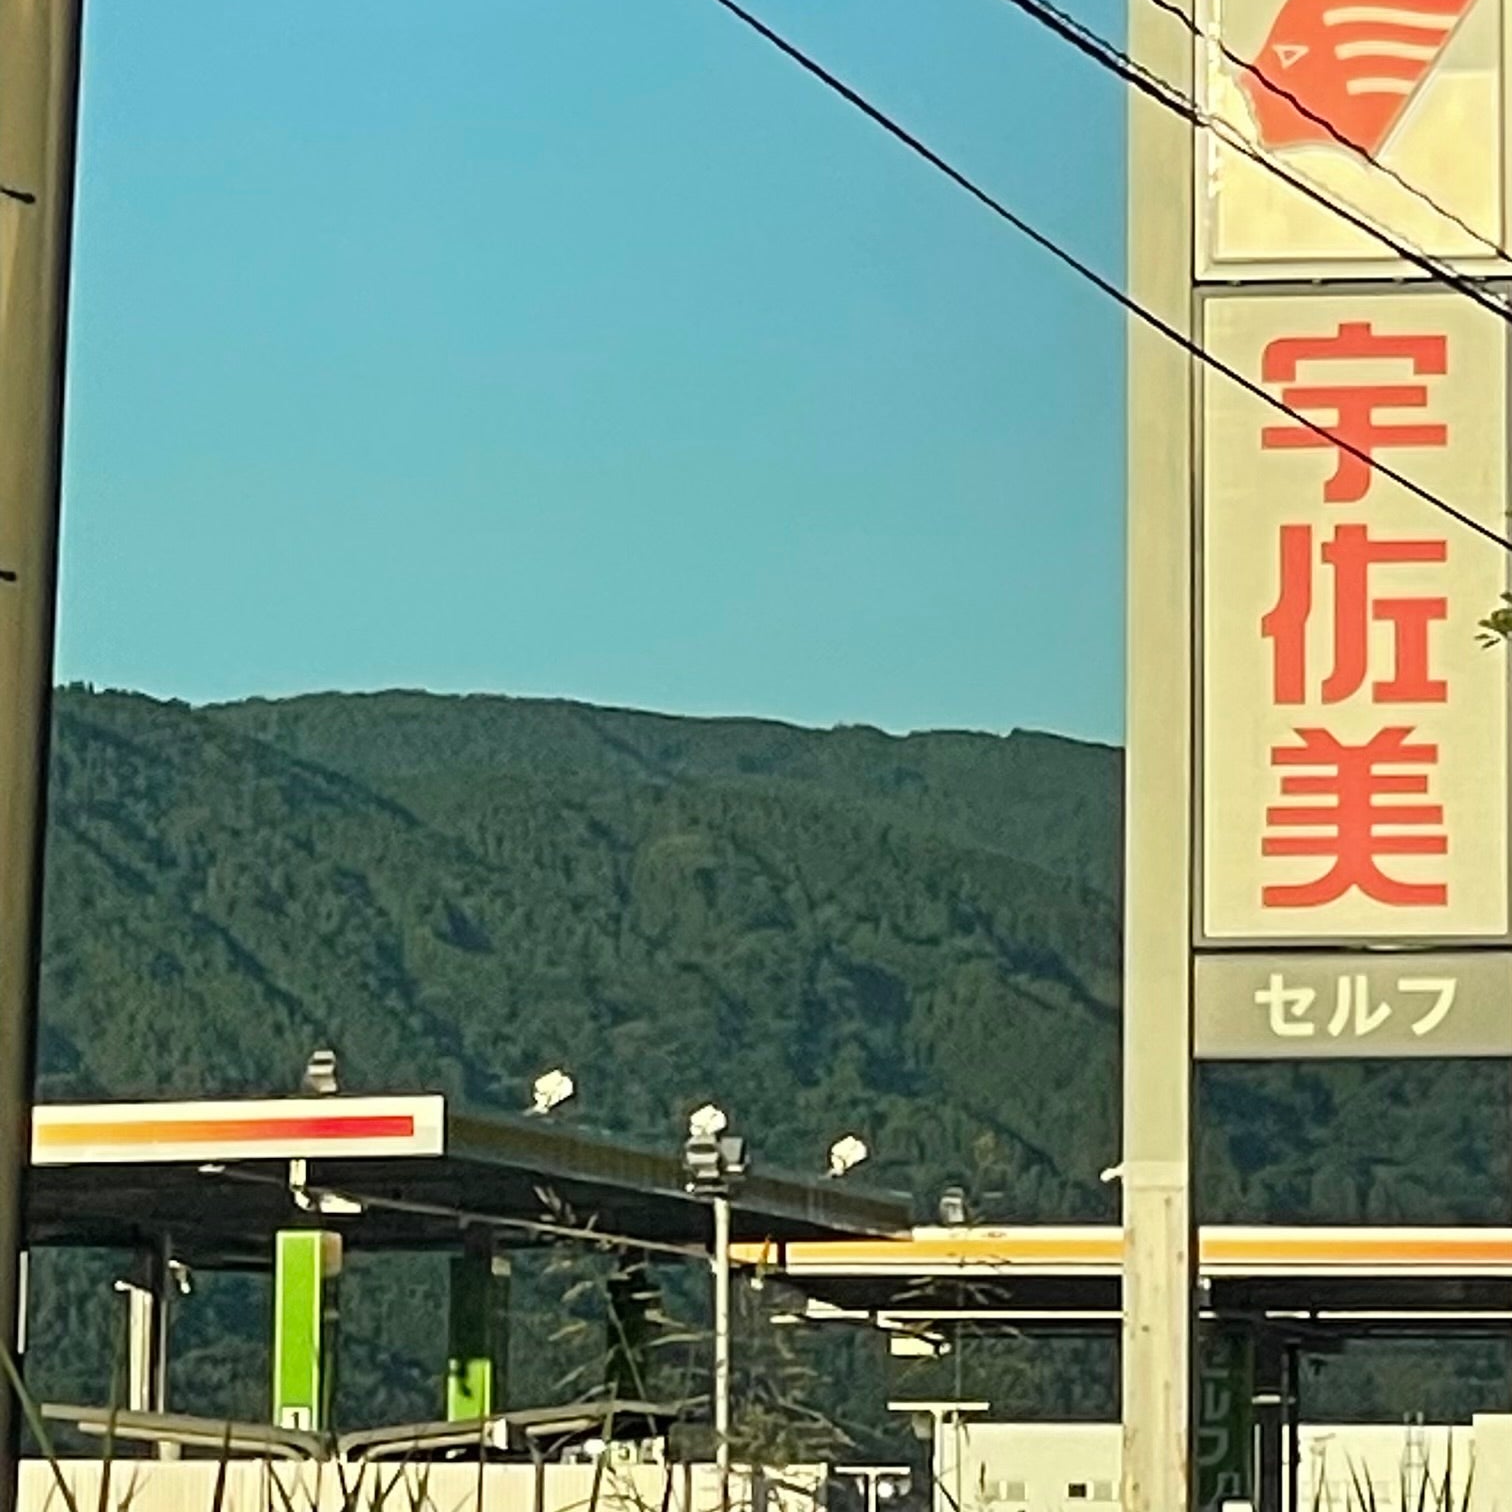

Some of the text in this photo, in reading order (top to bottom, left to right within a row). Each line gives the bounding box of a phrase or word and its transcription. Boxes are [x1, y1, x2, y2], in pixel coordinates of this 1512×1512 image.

[1261, 322, 1448, 907] 宇佐美
[1254, 973, 1457, 1037] セルフ
